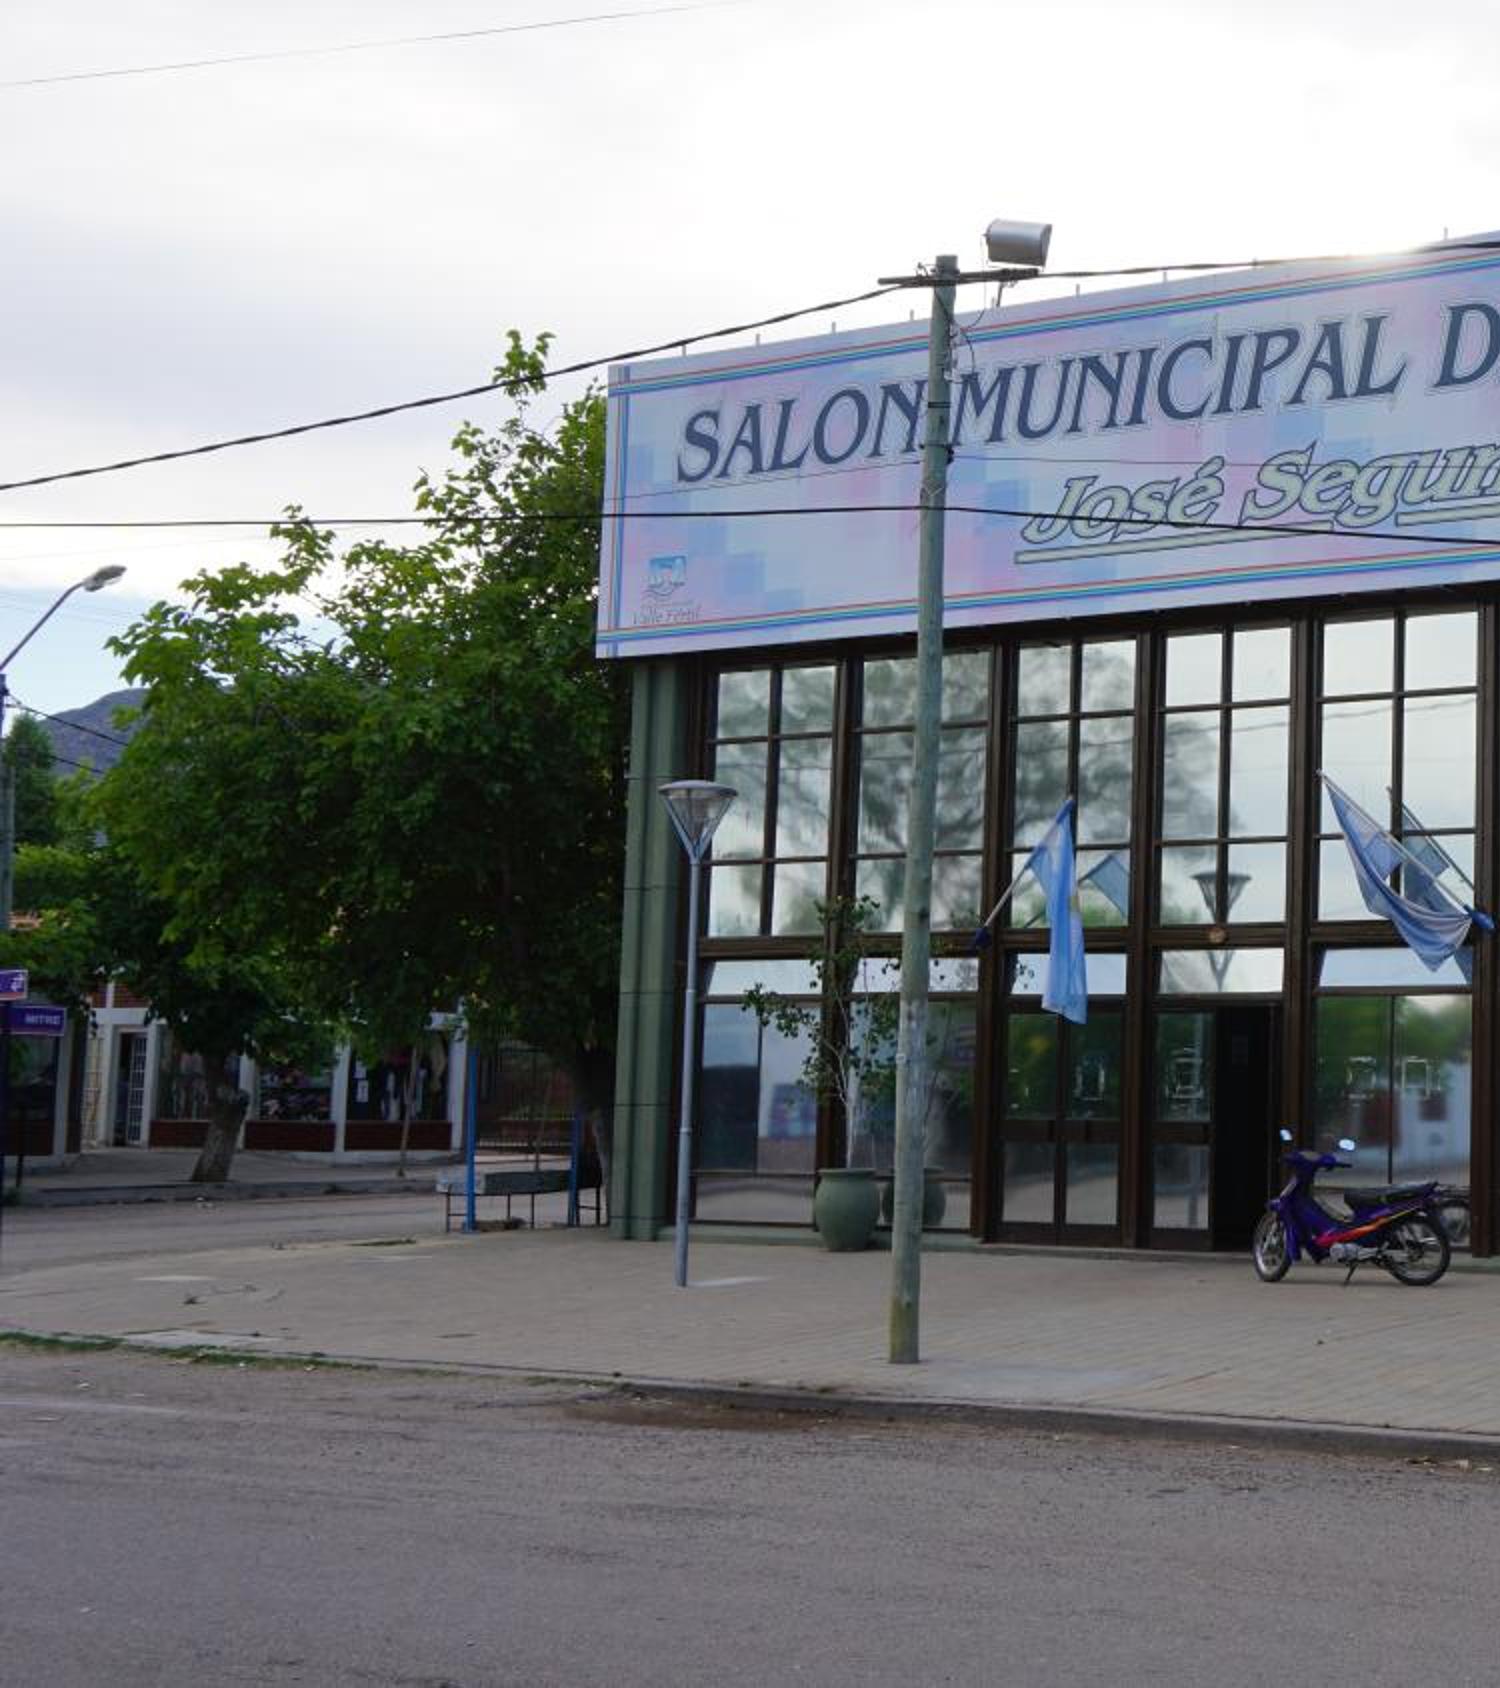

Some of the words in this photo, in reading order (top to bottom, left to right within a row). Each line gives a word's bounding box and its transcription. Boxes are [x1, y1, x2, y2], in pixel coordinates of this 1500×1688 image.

[676, 377, 928, 484] SALON
[950, 316, 1408, 447] MUNICIPAL
[1020, 455, 1226, 546] José
